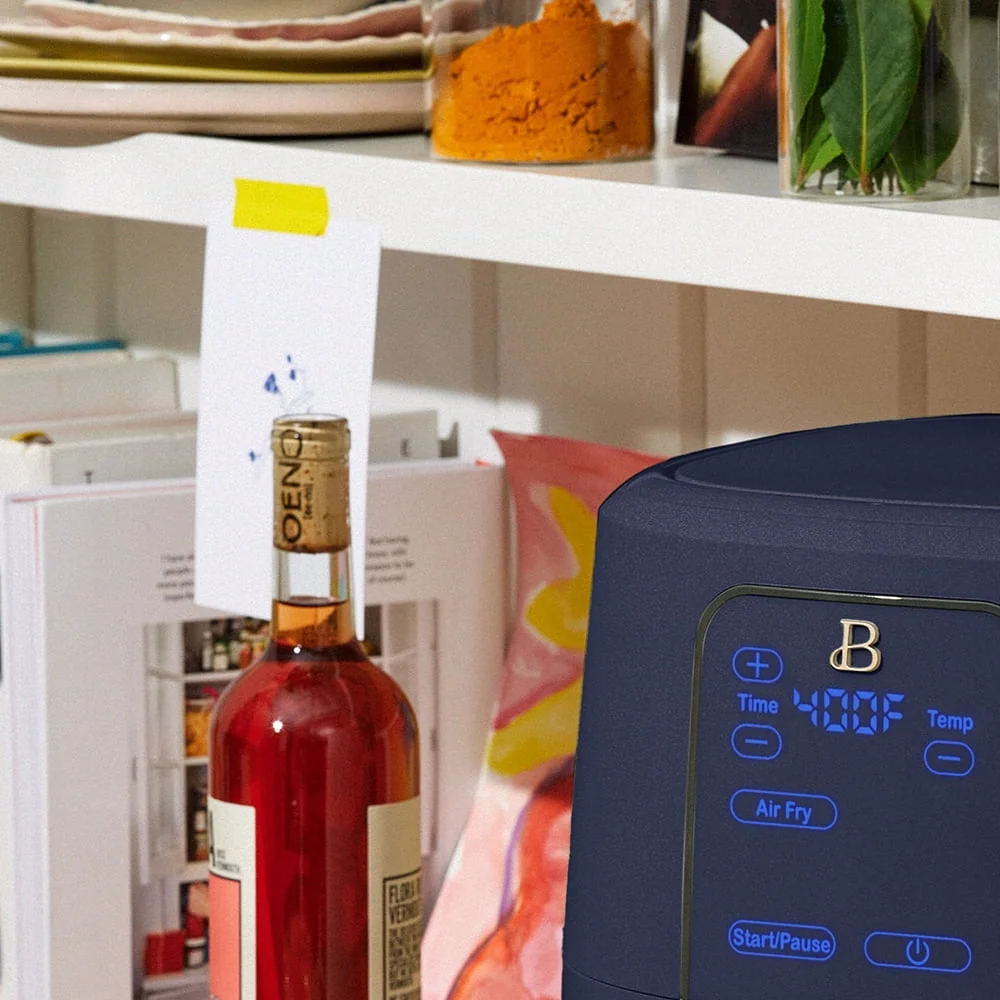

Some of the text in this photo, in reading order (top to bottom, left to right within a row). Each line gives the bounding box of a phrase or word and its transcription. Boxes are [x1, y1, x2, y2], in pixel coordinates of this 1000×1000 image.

[279, 429, 304, 544] OENO
[737, 688, 974, 735] Time 400F Temp
[755, 799, 812, 825] Air Fry
[732, 927, 831, 954] Start/Pause
